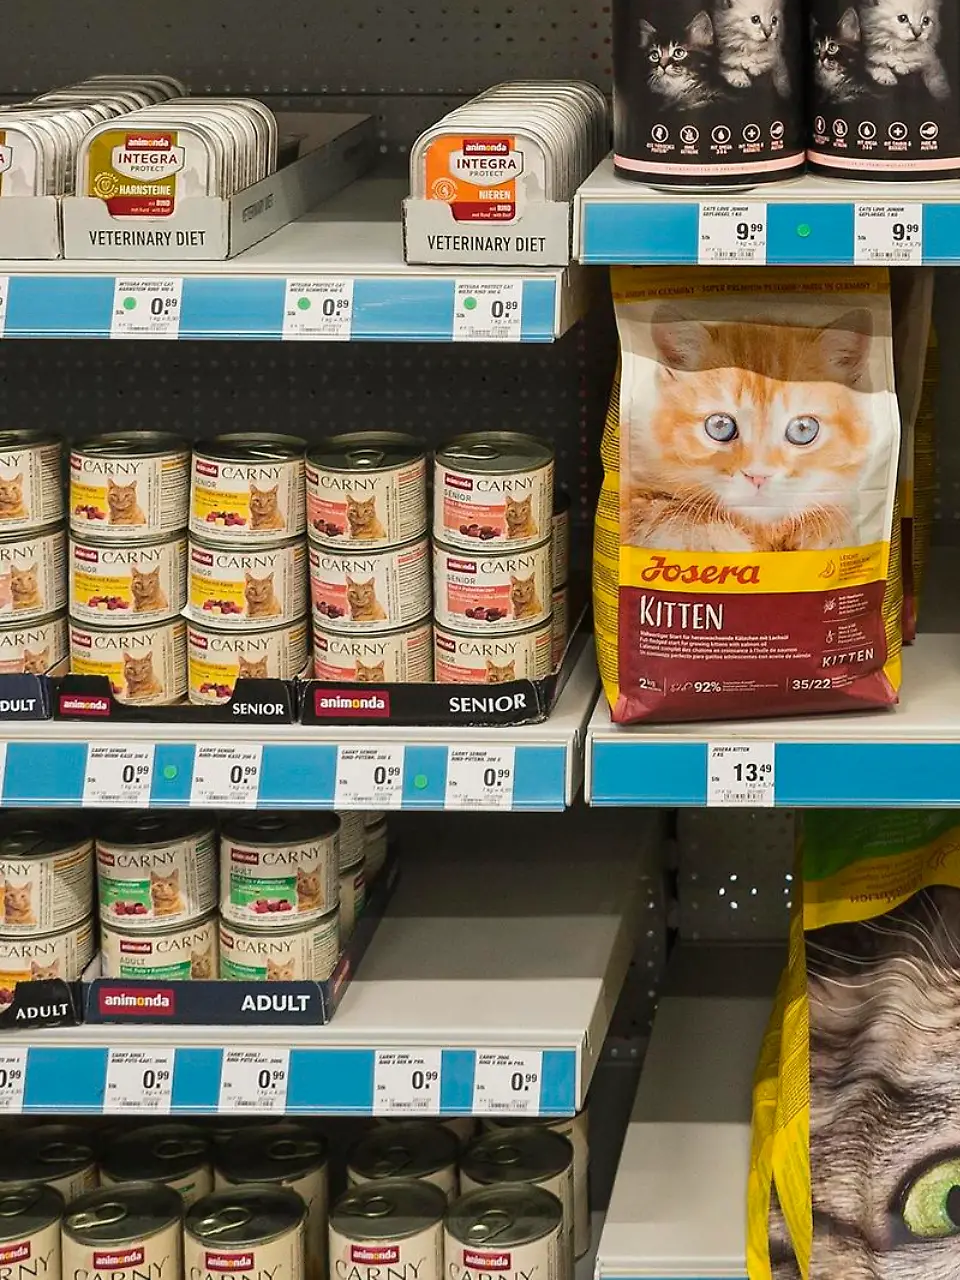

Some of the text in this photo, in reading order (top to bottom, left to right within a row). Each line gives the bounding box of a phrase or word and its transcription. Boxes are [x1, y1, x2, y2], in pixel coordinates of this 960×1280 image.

[128, 138, 169, 148] animonda
[465, 142, 506, 152] animonda
[118, 153, 178, 164] INTEGRA
[456, 158, 516, 169] INTEGRA
[120, 184, 171, 196] HARNSTEINE
[479, 190, 510, 200] NIEREN
[89, 231, 206, 246] VETERINARY DIET
[736, 222, 763, 240] 9.99
[428, 236, 546, 252] VETERINARY DIET
[84, 460, 141, 475] CARNY
[321, 475, 379, 491] CARNY
[476, 475, 538, 492] CARNY
[481, 554, 538, 574] CARNY
[641, 555, 760, 584] Josera
[640, 594, 723, 630] KITTEN
[822, 648, 874, 667] KITTEN
[694, 679, 831, 693] 92% 35/22
[63, 699, 284, 716] animonda SENIOR
[320, 693, 526, 713] animonda SENIOR
[733, 763, 772, 781] 13.49
[117, 852, 176, 868] CARNY
[262, 846, 321, 866] CARNY
[104, 994, 310, 1012] animonda ADULT
[16, 1004, 68, 1020] ADULT
[96, 1252, 142, 1266] animonda
[353, 1249, 396, 1260] animonda
